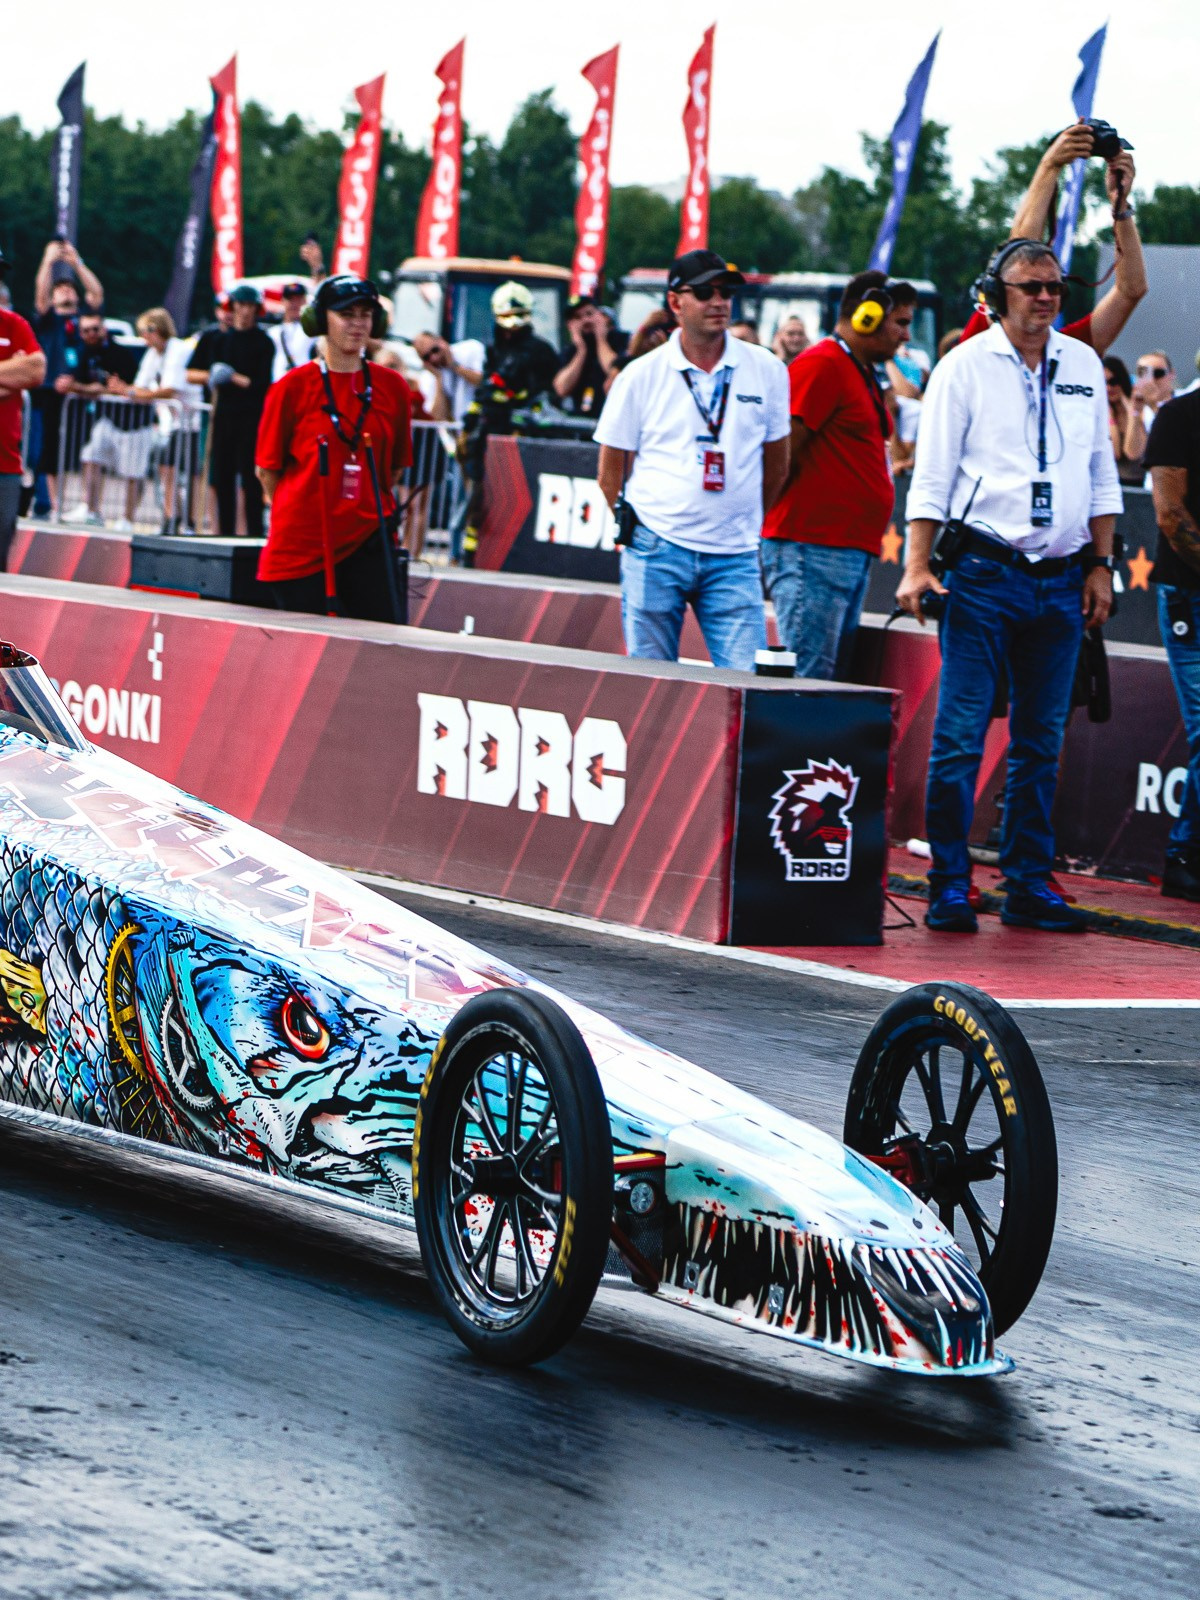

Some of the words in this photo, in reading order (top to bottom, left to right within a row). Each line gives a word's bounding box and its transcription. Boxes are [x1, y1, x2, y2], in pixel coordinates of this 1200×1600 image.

[50, 677, 161, 744] GONKI
[417, 692, 627, 826] RDRC
[790, 861, 847, 878] RDRC
[932, 995, 1018, 1118] GOODYEAR
